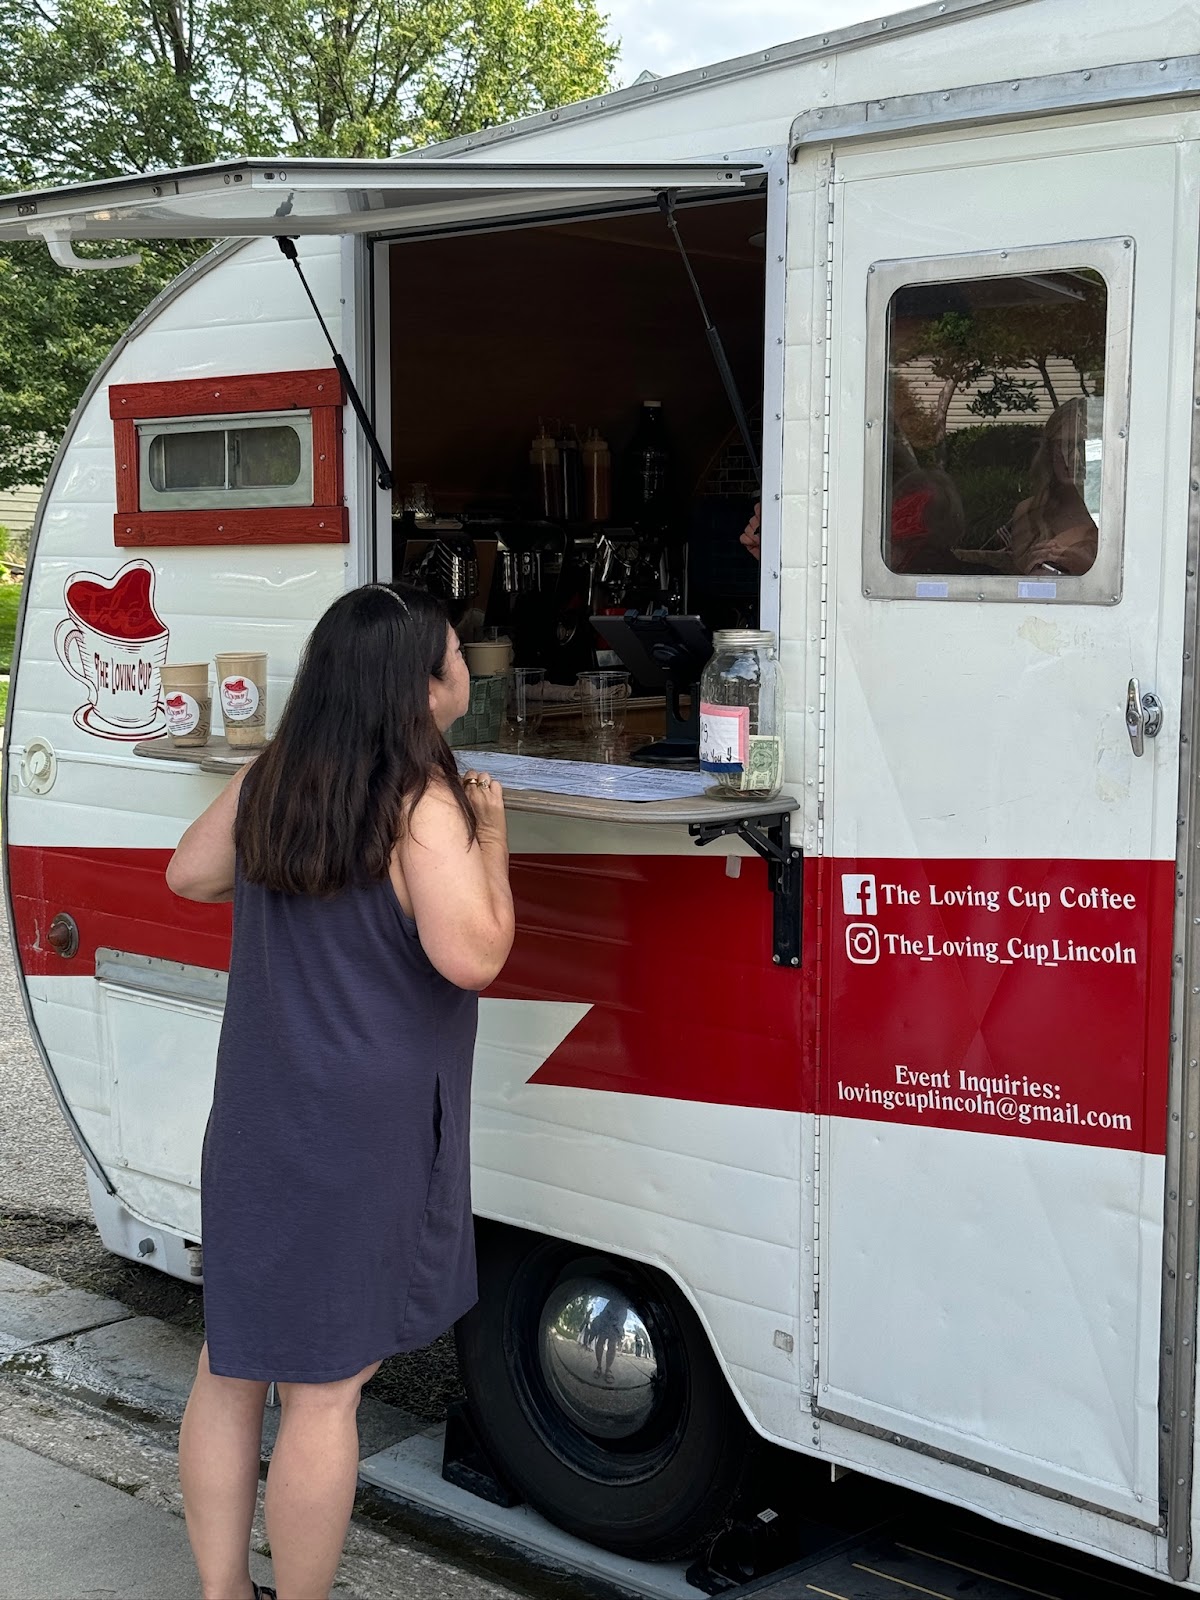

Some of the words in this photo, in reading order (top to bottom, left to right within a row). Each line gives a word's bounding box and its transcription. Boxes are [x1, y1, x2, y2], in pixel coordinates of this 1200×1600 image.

[111, 657, 136, 695] LOVING
[138, 658, 153, 696] CUP
[881, 884, 921, 905] The
[929, 885, 1000, 912] Loving
[1008, 886, 1051, 914] Cup
[1060, 887, 1137, 910] Coffee
[884, 934, 1137, 966] The_Loving_Cup_Lincoln
[895, 1065, 951, 1091] Event
[959, 1070, 1062, 1100] Inquiries:
[837, 1081, 1133, 1131] lovingcuplincoln@gmail.com
